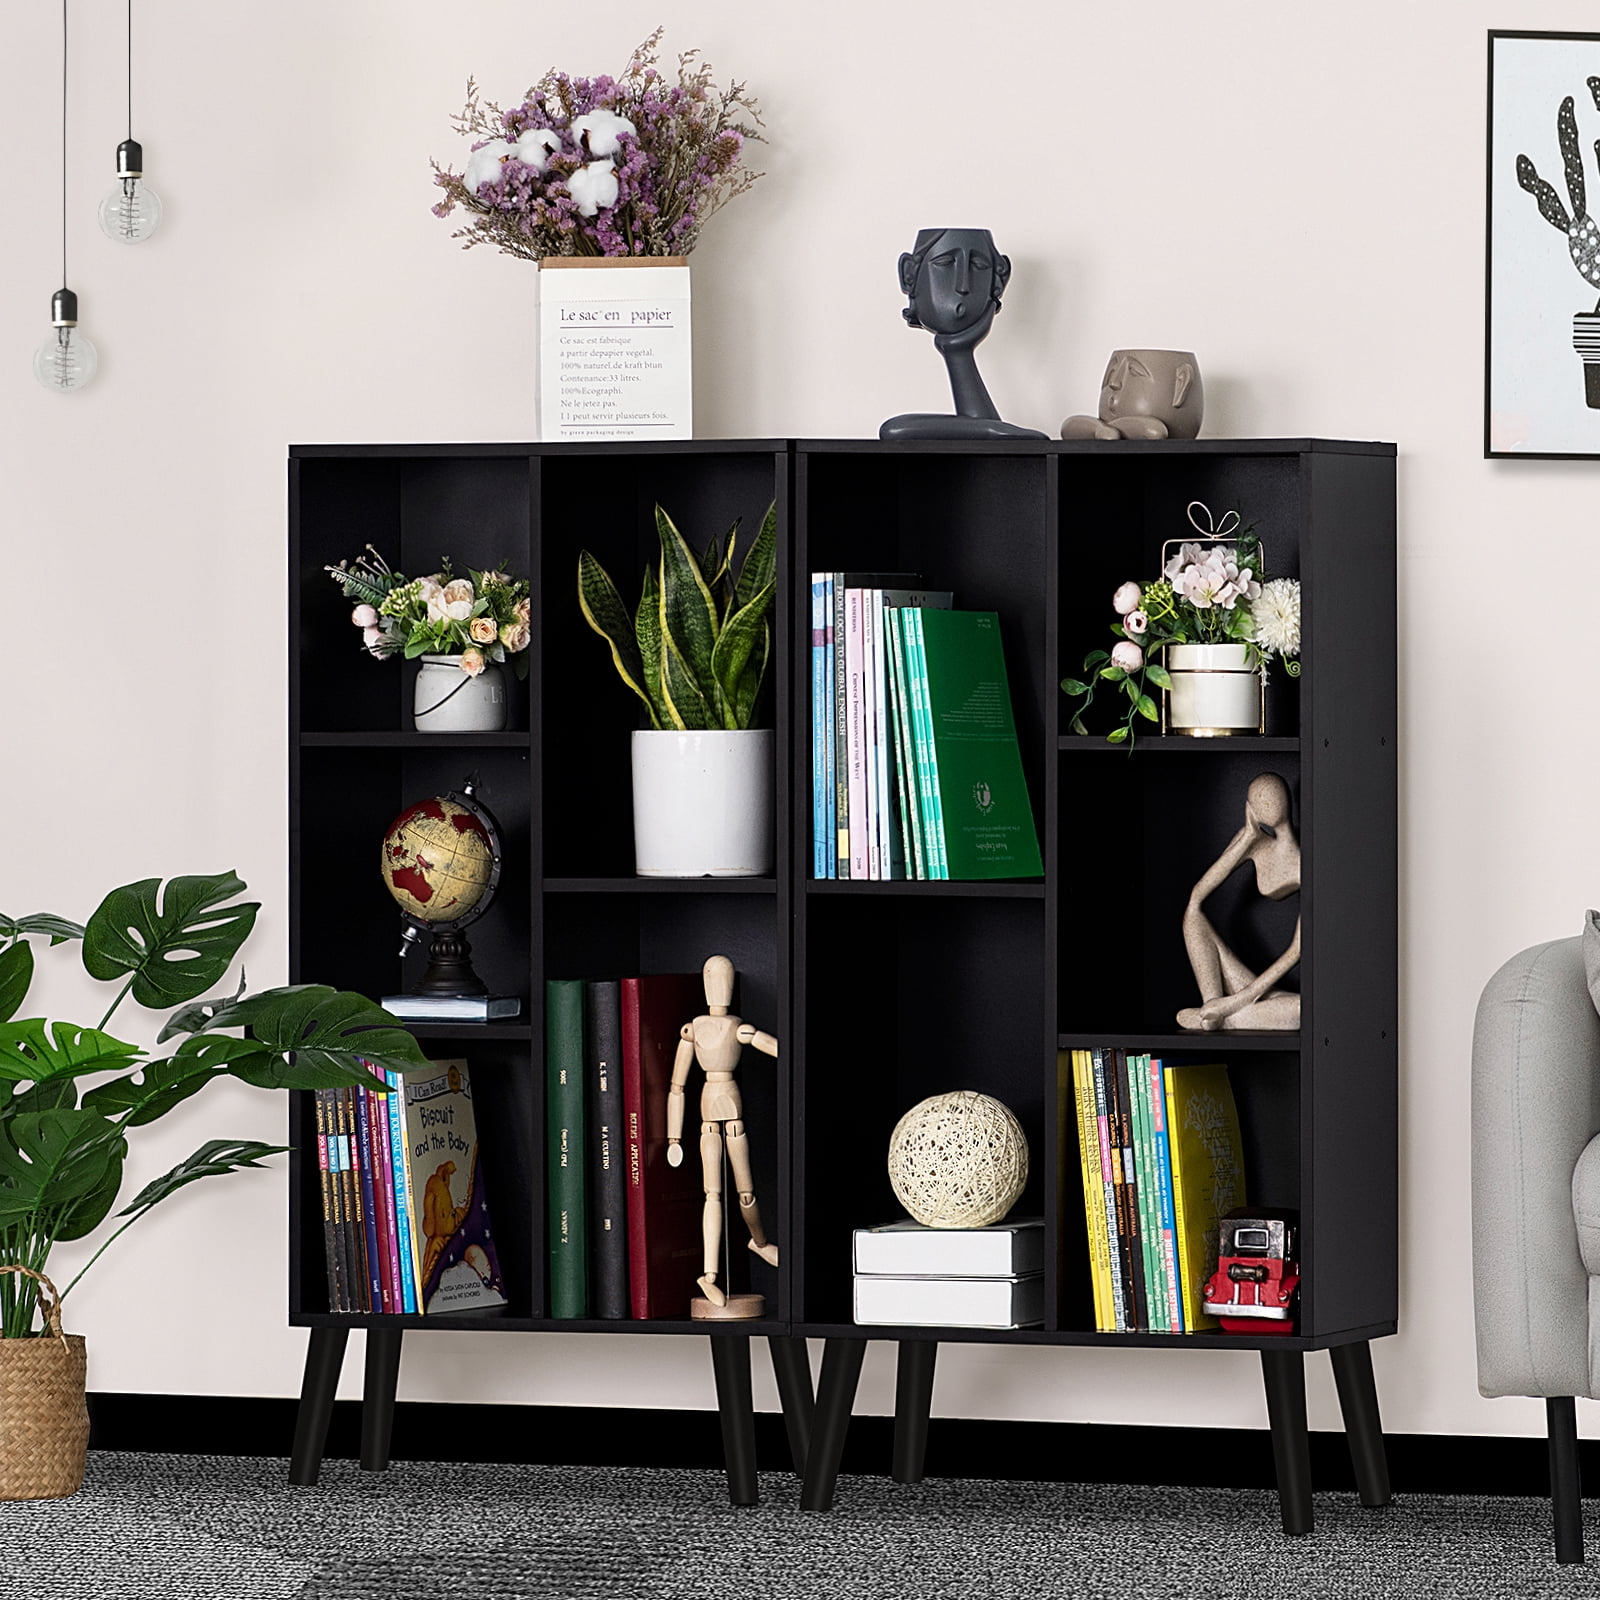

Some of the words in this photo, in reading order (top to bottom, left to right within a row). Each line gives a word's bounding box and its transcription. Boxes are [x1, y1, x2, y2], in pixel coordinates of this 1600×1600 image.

[561, 308, 576, 321] Le
[604, 311, 619, 321] en
[631, 308, 671, 324] papier
[599, 337, 632, 346] fabrique
[560, 362, 581, 370] 100%
[624, 361, 642, 369] kraft
[566, 350, 588, 359] partir
[620, 374, 641, 382] litres.
[574, 399, 581, 407] le
[582, 399, 600, 408] jetez
[573, 413, 590, 421] peut
[616, 411, 651, 421] plusieurs
[652, 411, 669, 419] fois.
[836, 613, 844, 643] LOCAL
[836, 646, 844, 657] TO
[837, 659, 845, 695] GLOBAL
[837, 697, 845, 735] ENGLISH
[413, 1086, 417, 1097] I
[418, 1085, 430, 1097] Can
[430, 1078, 447, 1094] Read!
[1094, 1073, 1105, 1107] JOURNAL
[389, 1098, 399, 1114] THE
[1129, 1087, 1137, 1116] Englishes
[419, 1105, 455, 1128] Biscuit
[390, 1116, 401, 1153] JOURNAL
[415, 1135, 430, 1157] and
[431, 1132, 445, 1150] the
[448, 1131, 469, 1157] Baby
[560, 1128, 568, 1152] (Curtin)
[1109, 1122, 1117, 1146] JOURNAL
[320, 1154, 326, 1163] NO
[329, 1156, 336, 1164] NO
[362, 1145, 370, 1169] Selections
[393, 1155, 402, 1167] OF
[560, 1154, 568, 1166] PhD
[601, 1140, 609, 1169] (CURTIN)
[393, 1170, 403, 1189] ASIA
[322, 1192, 330, 1221] AUSTRALIA
[332, 1195, 340, 1224] AUSTRALIA
[343, 1193, 351, 1222] AUSTRALIA
[395, 1192, 404, 1210] TEFL
[1161, 1196, 1169, 1219] JOURNAL
[560, 1210, 568, 1234] ADNAN
[1116, 1206, 1124, 1235] AUSTRALIA
[1129, 1207, 1137, 1236] AUSTRALIA
[1163, 1237, 1176, 1290] WORLD-WIDE
[1167, 1290, 1178, 1323] ENGLISH
